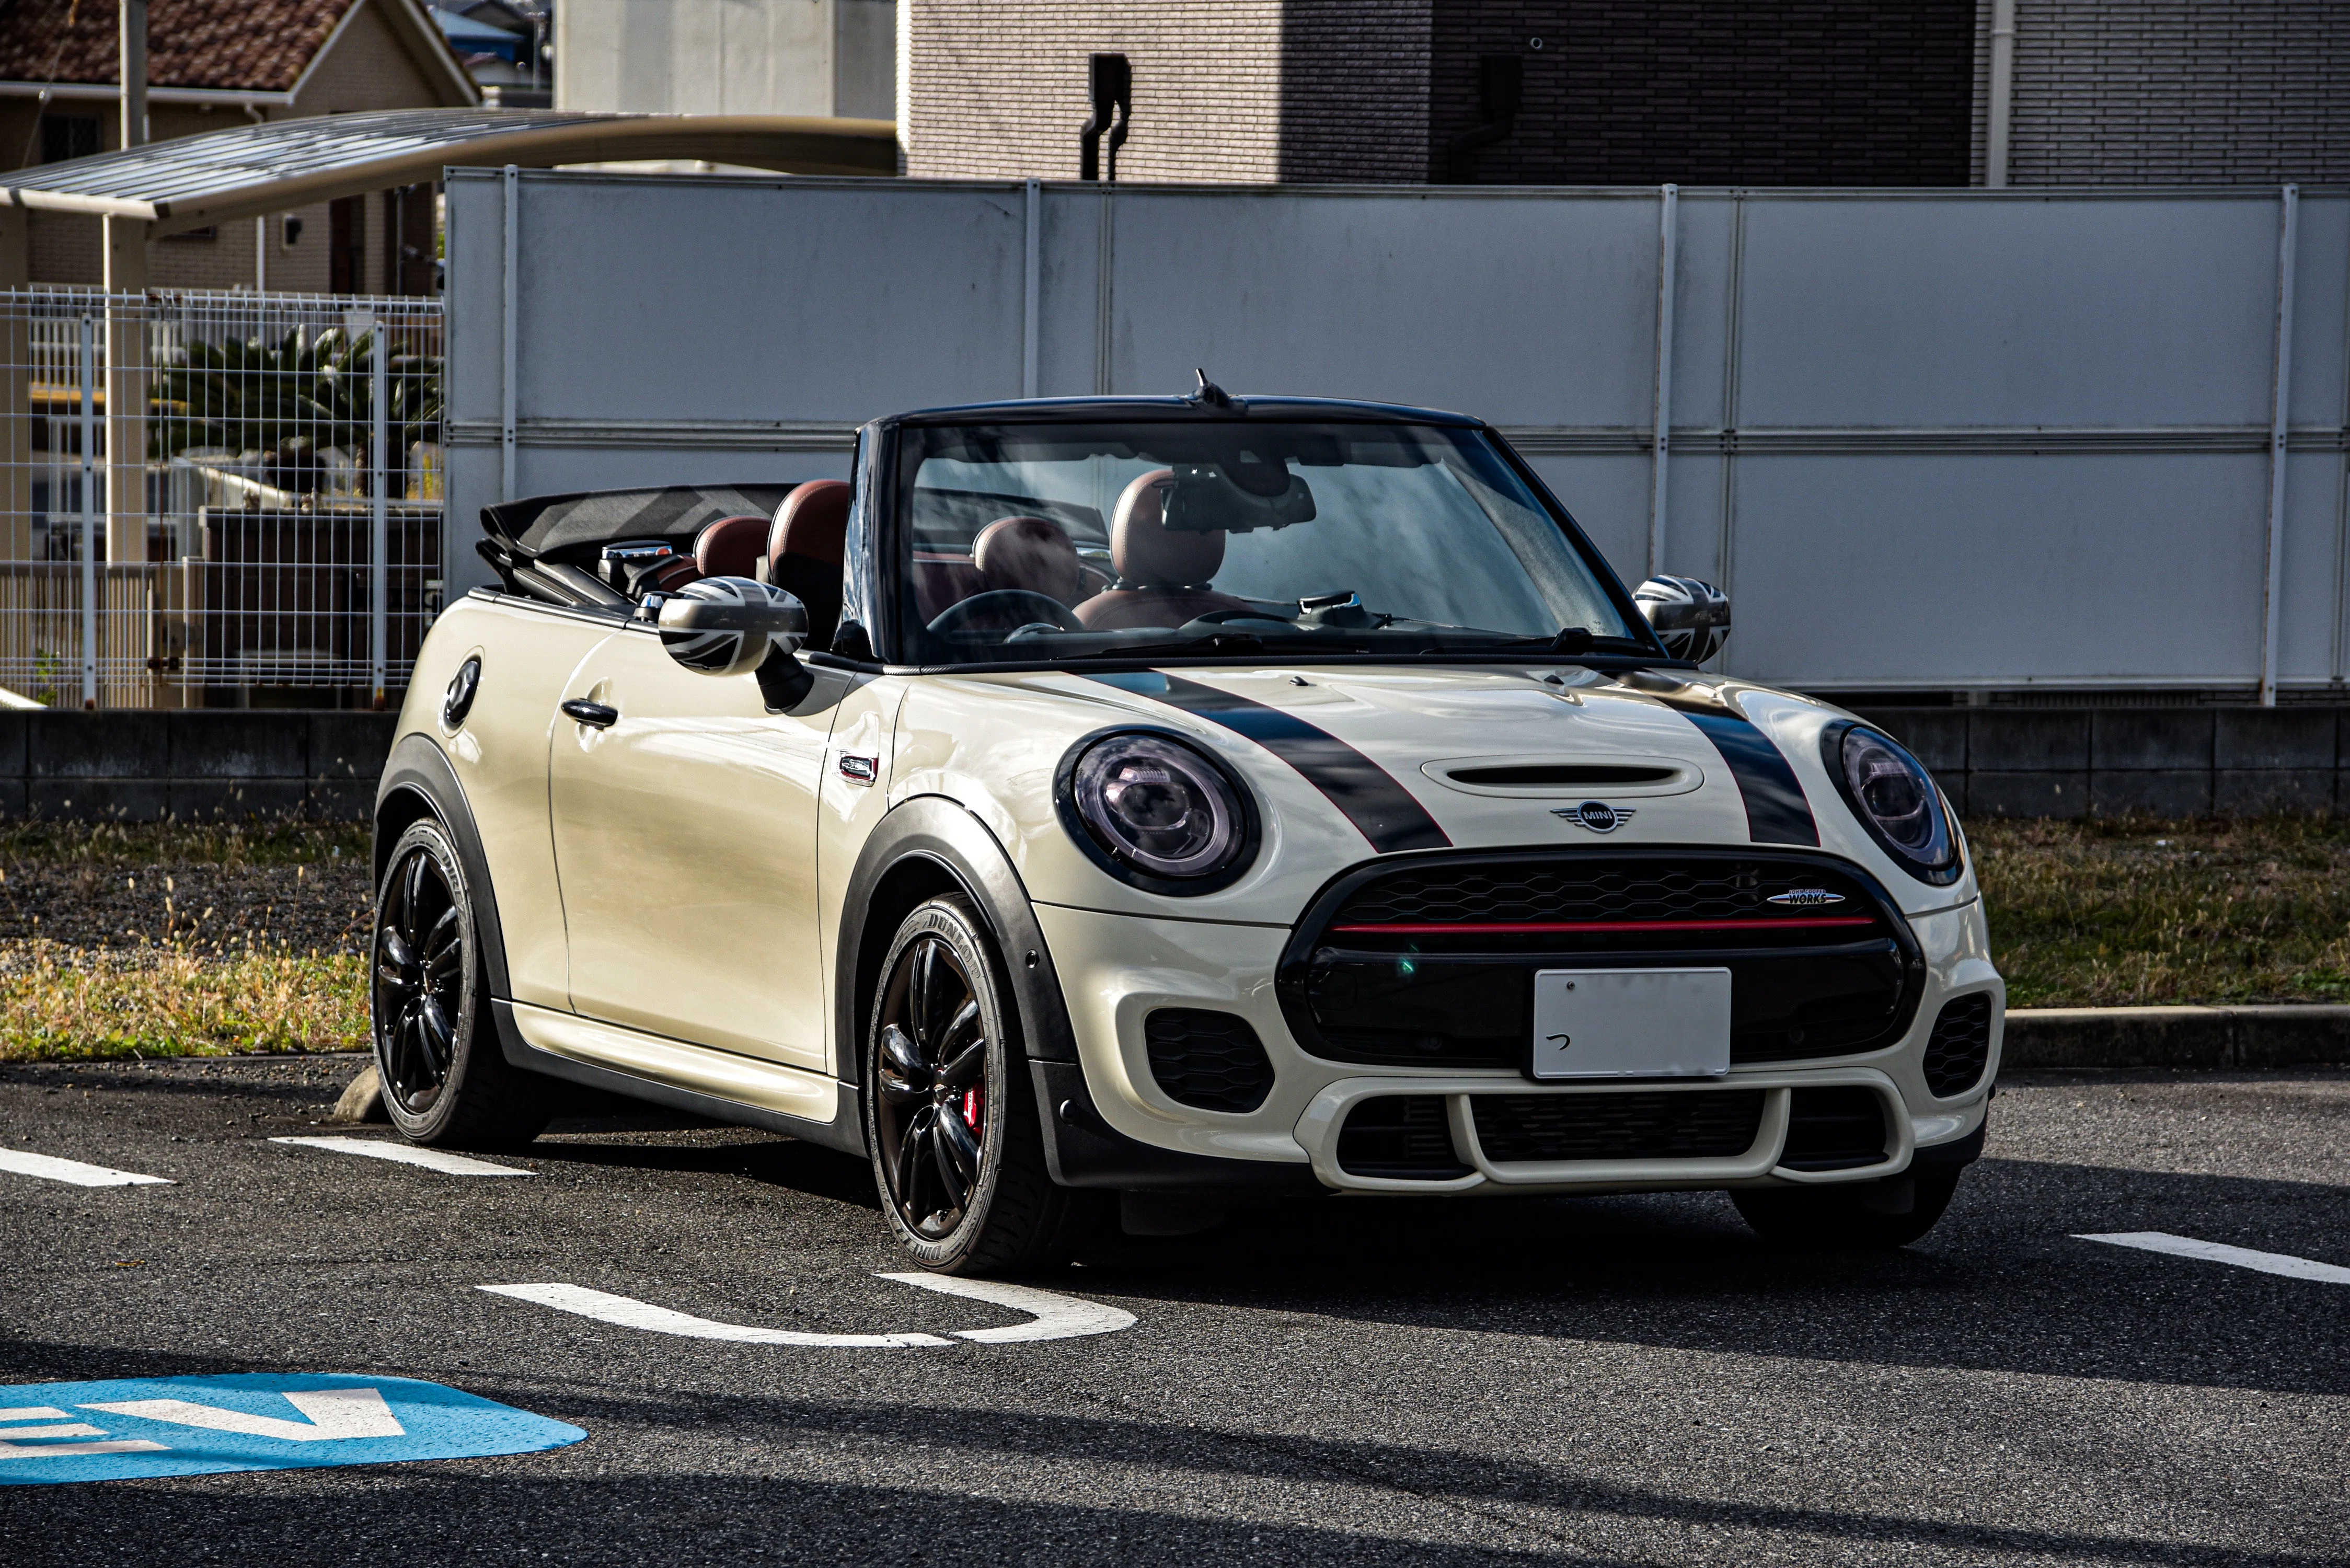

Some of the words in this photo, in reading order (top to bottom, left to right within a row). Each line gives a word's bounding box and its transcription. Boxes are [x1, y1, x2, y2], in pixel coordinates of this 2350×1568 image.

[1583, 811, 1612, 820] MINI
[1789, 894, 1827, 904] WORKS
[927, 914, 981, 978] DUNLOP
